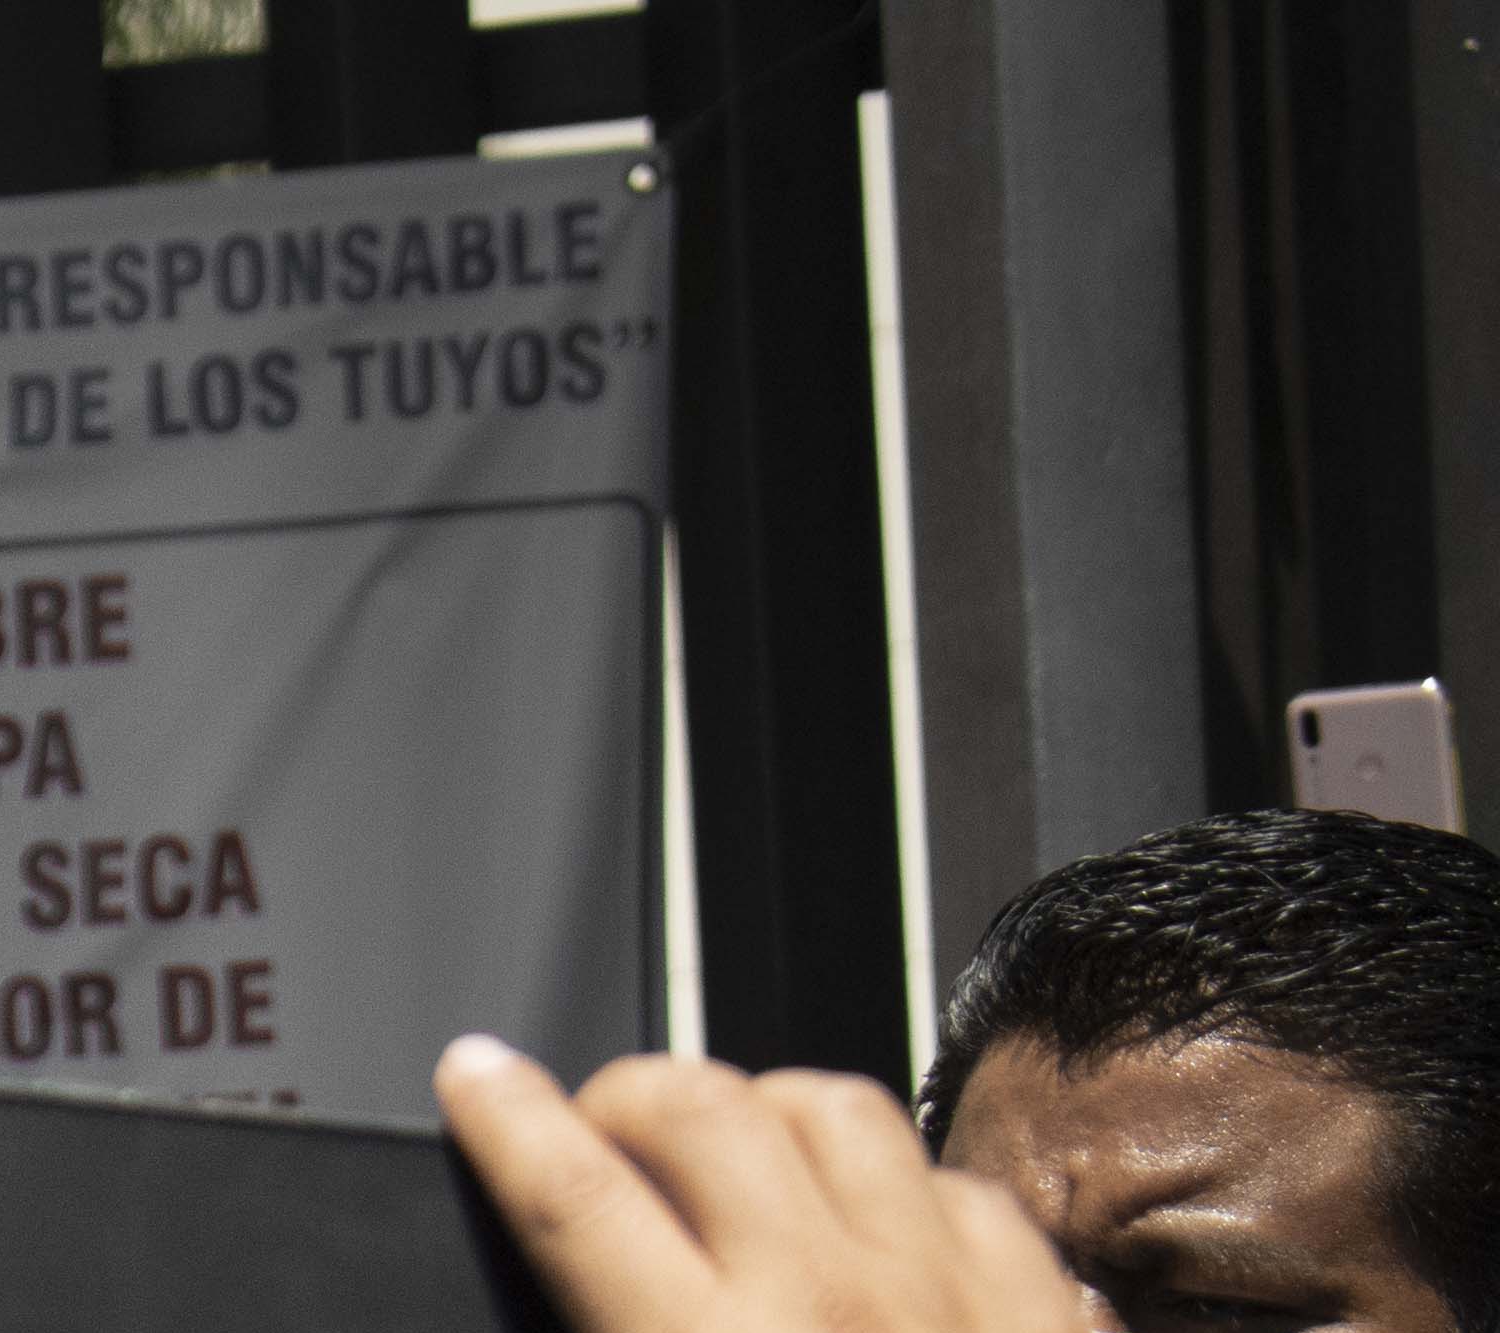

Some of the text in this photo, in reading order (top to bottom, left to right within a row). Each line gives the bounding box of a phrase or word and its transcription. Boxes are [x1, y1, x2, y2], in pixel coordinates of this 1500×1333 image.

[11, 368, 111, 450] DE
[147, 350, 298, 439] LOS
[21, 831, 260, 930] SECA
[157, 961, 276, 1050] DE
